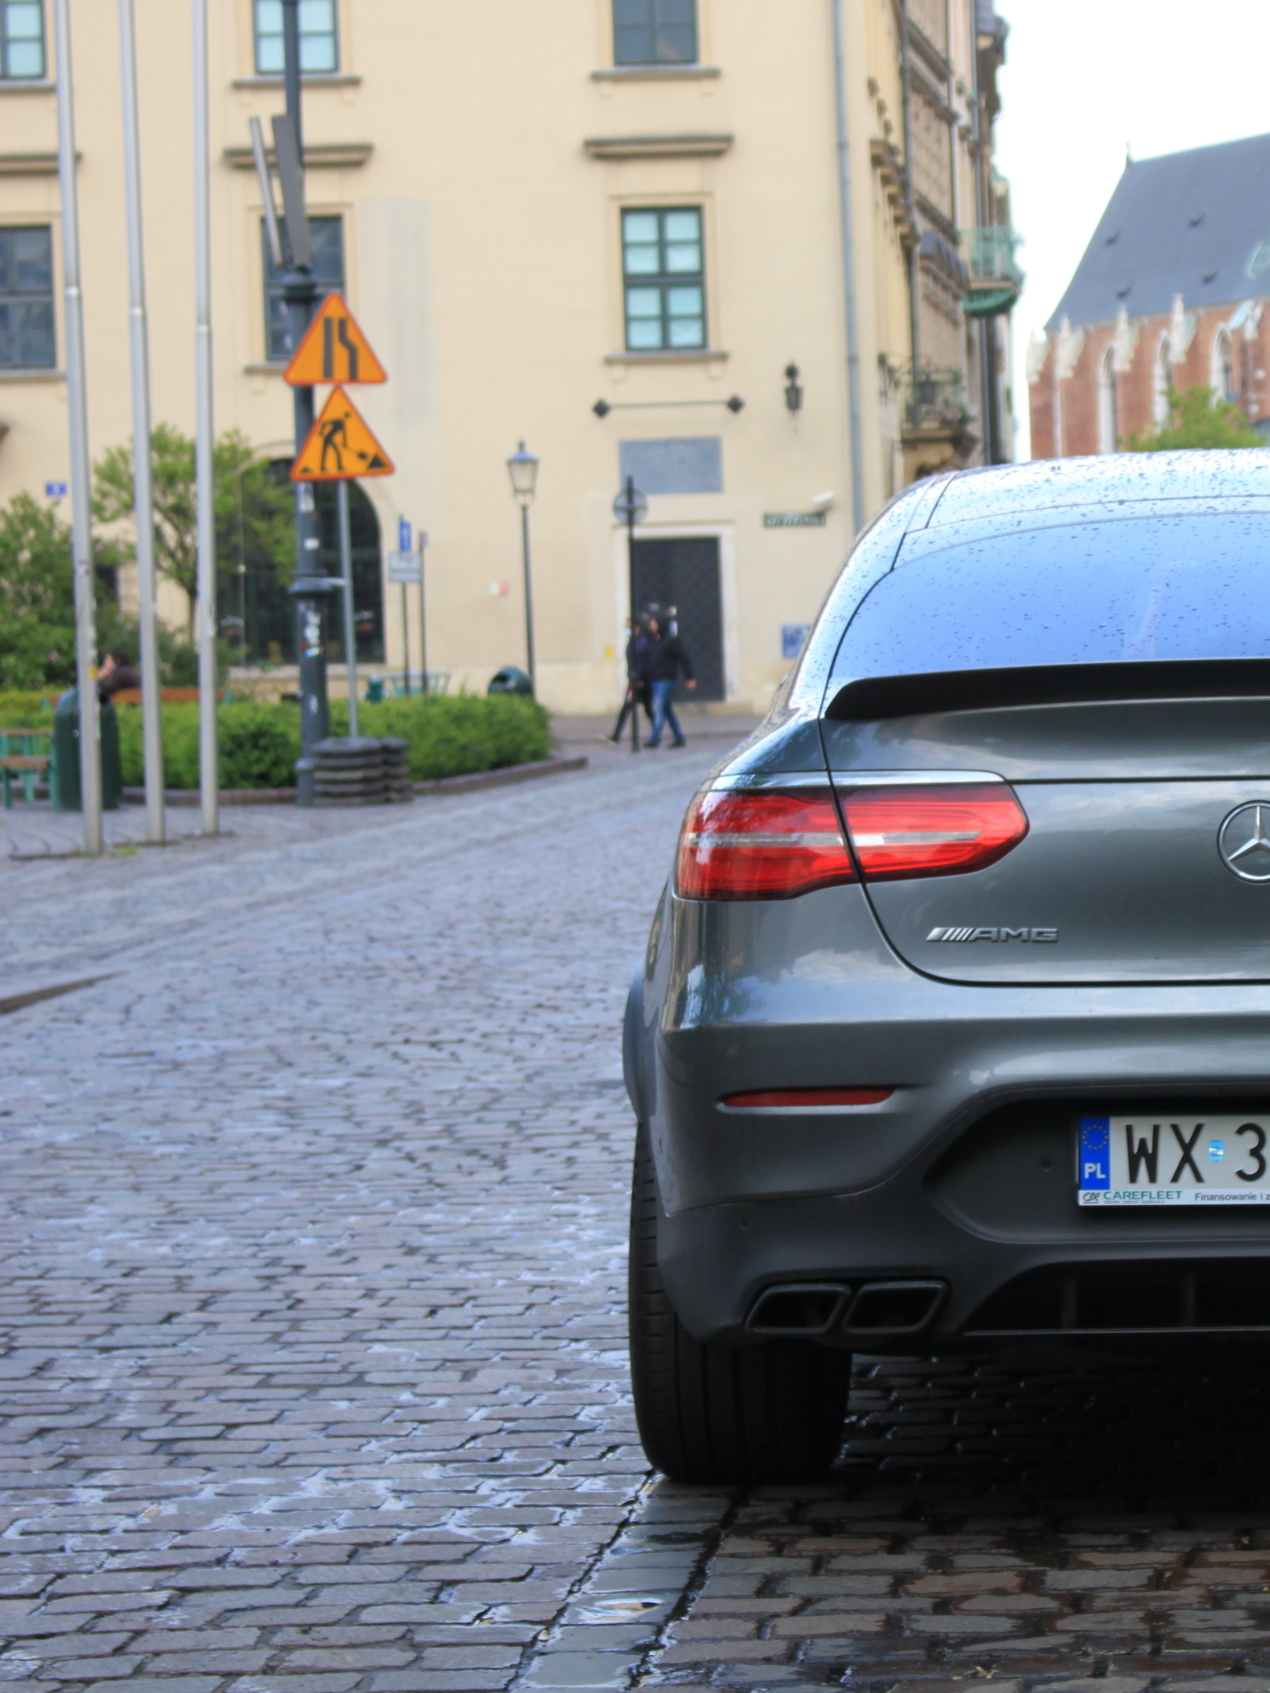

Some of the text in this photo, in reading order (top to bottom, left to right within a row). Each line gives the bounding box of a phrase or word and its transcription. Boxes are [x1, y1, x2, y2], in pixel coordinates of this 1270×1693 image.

[968, 927, 1058, 943] AMG
[1125, 1123, 1205, 1184] WX
[1084, 1163, 1106, 1179] PL
[1103, 1190, 1183, 1200] CAREFLEET
[1195, 1193, 1257, 1201] Finansowanie
